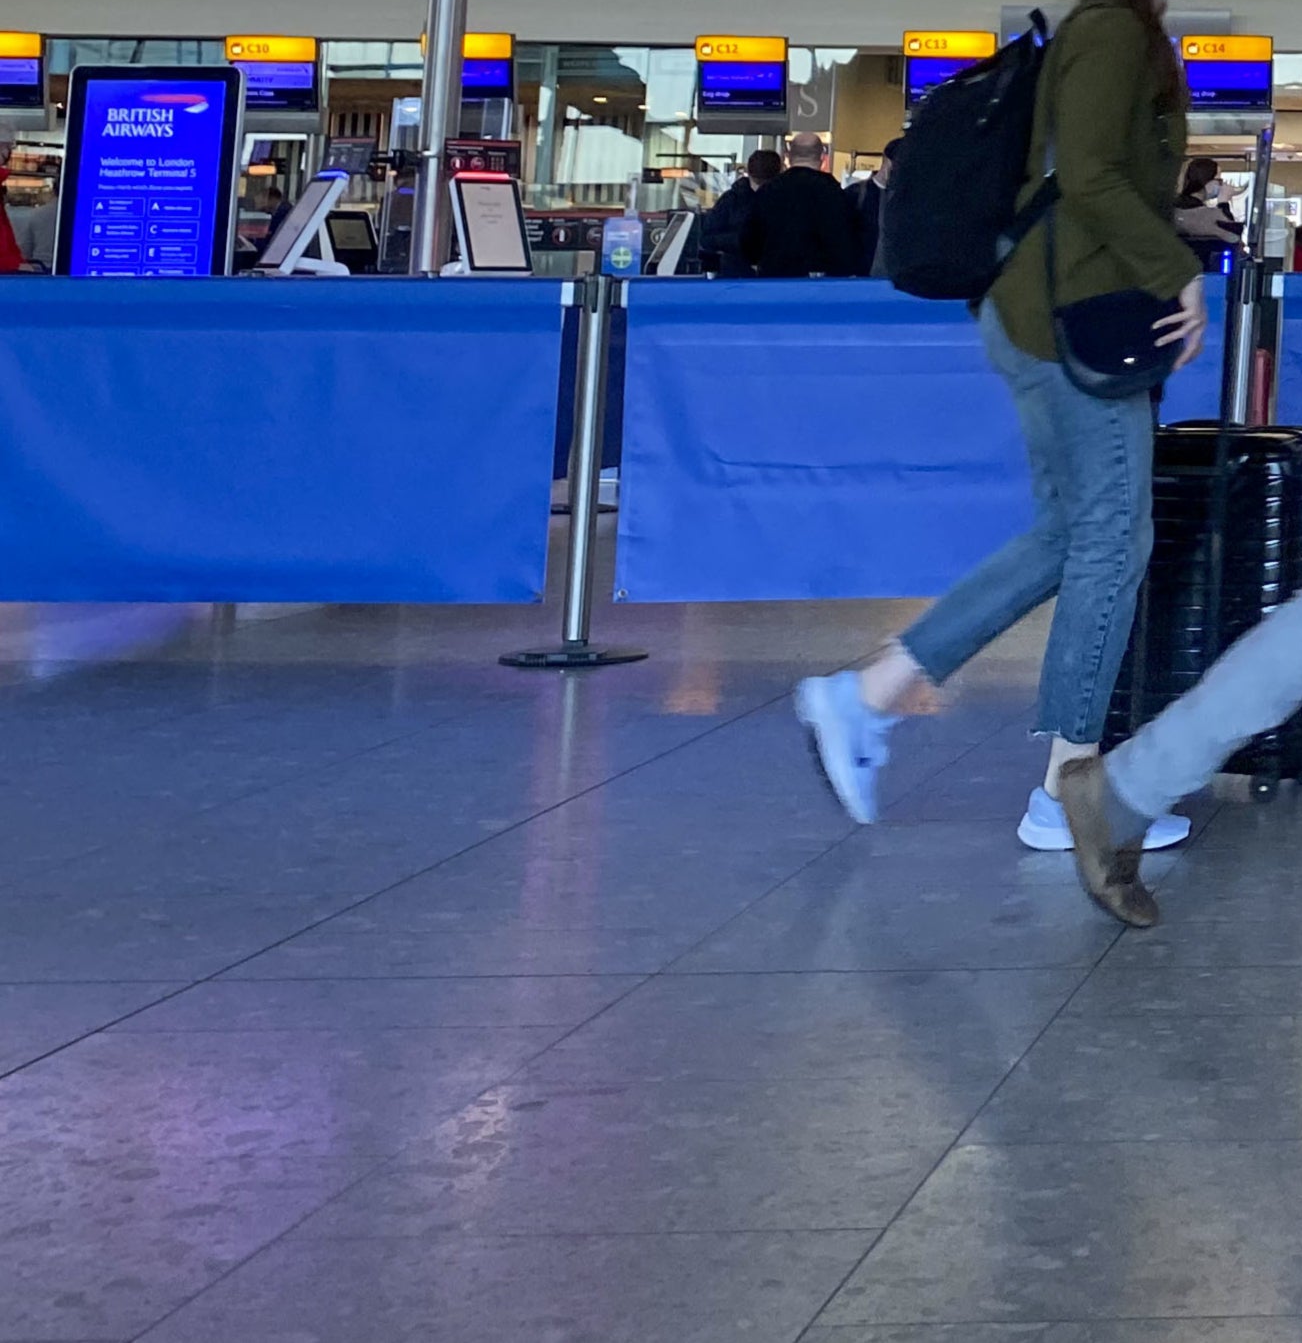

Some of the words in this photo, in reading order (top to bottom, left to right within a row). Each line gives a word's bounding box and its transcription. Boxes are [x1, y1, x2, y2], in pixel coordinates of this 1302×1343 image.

[247, 44, 270, 54] C10
[716, 44, 739, 54] C12
[924, 39, 948, 50] C13
[1202, 43, 1226, 54] C14
[107, 108, 174, 122] BRITISH
[101, 123, 174, 137] AIRWAYS
[100, 157, 144, 167] Welcome
[146, 158, 157, 167] to
[158, 157, 195, 167] London
[99, 168, 146, 177] Heathrow
[148, 168, 187, 178] Terminal
[189, 168, 197, 178] 5
